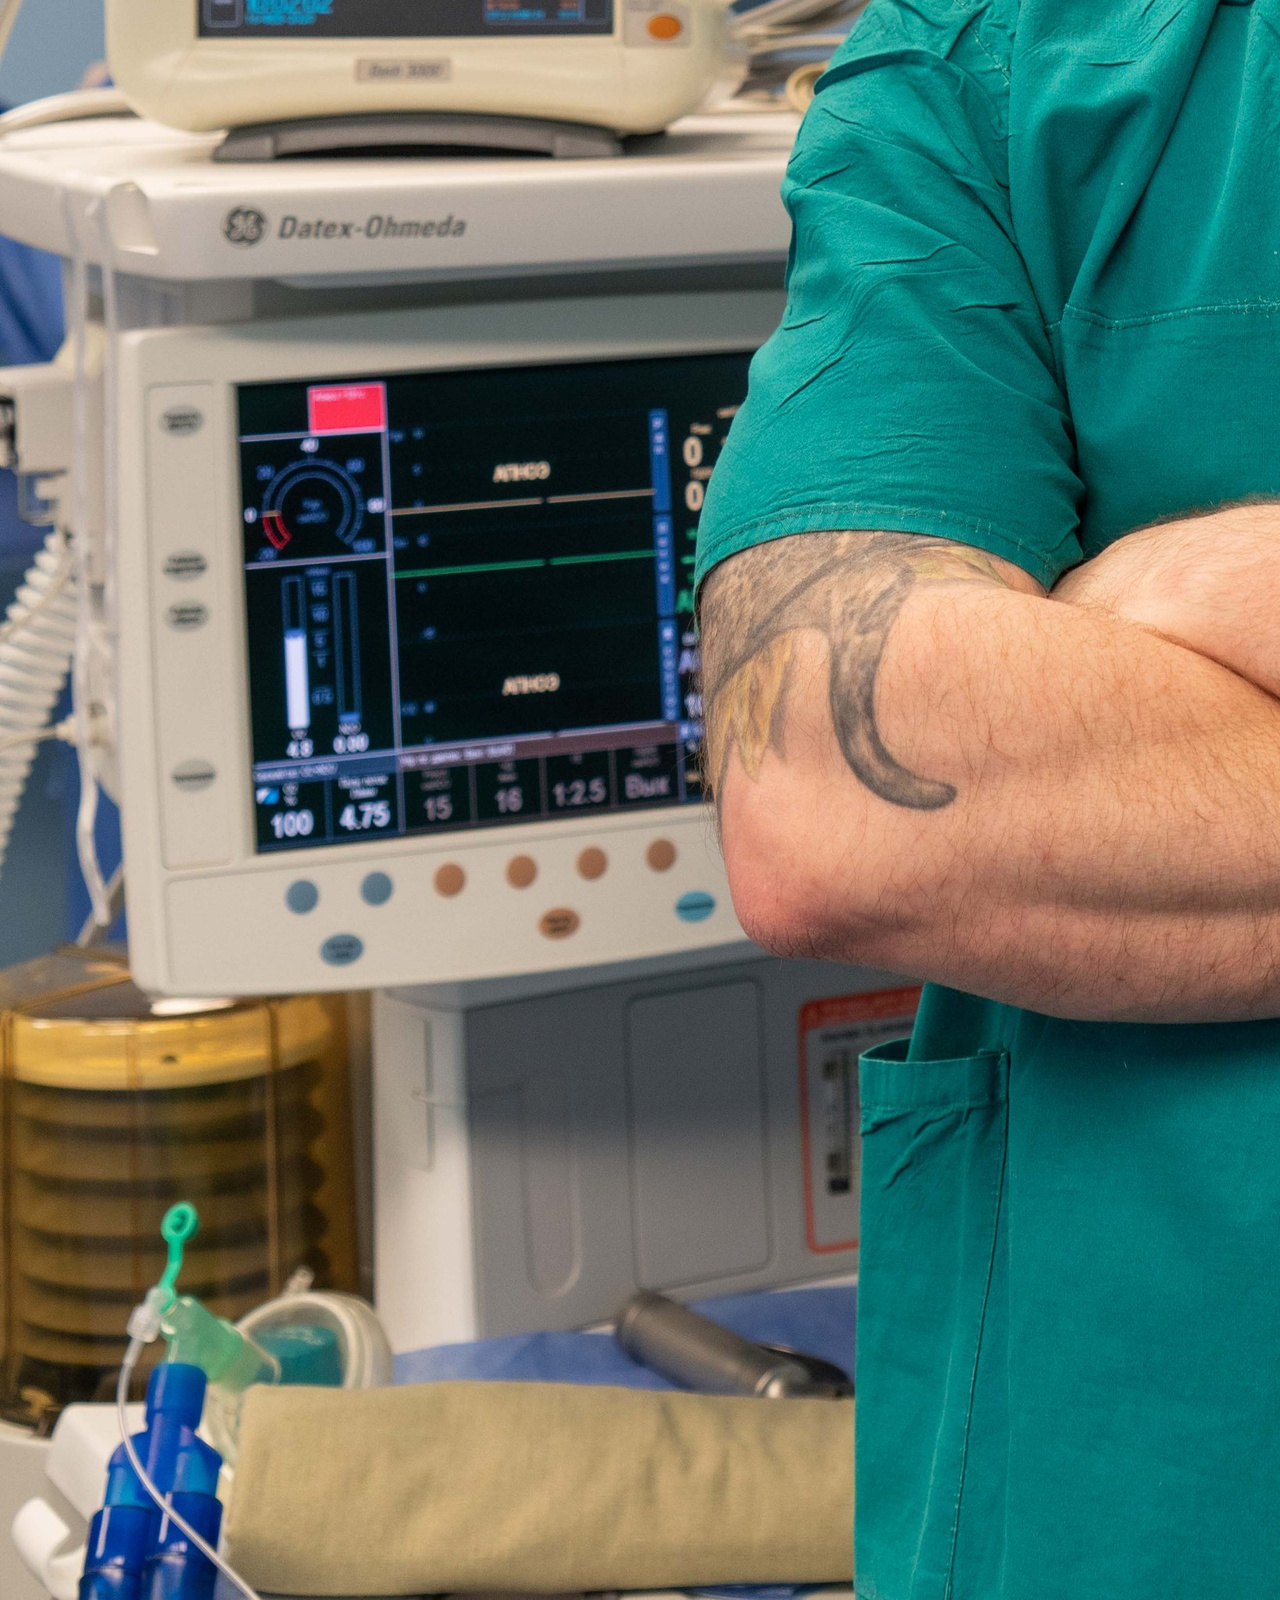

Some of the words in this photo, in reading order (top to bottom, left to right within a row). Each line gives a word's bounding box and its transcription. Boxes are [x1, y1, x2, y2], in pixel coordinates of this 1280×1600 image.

[279, 214, 467, 240] Datex-Ohmeda
[683, 437, 703, 467] 0
[270, 808, 314, 839] 100
[338, 801, 391, 831] 4.75
